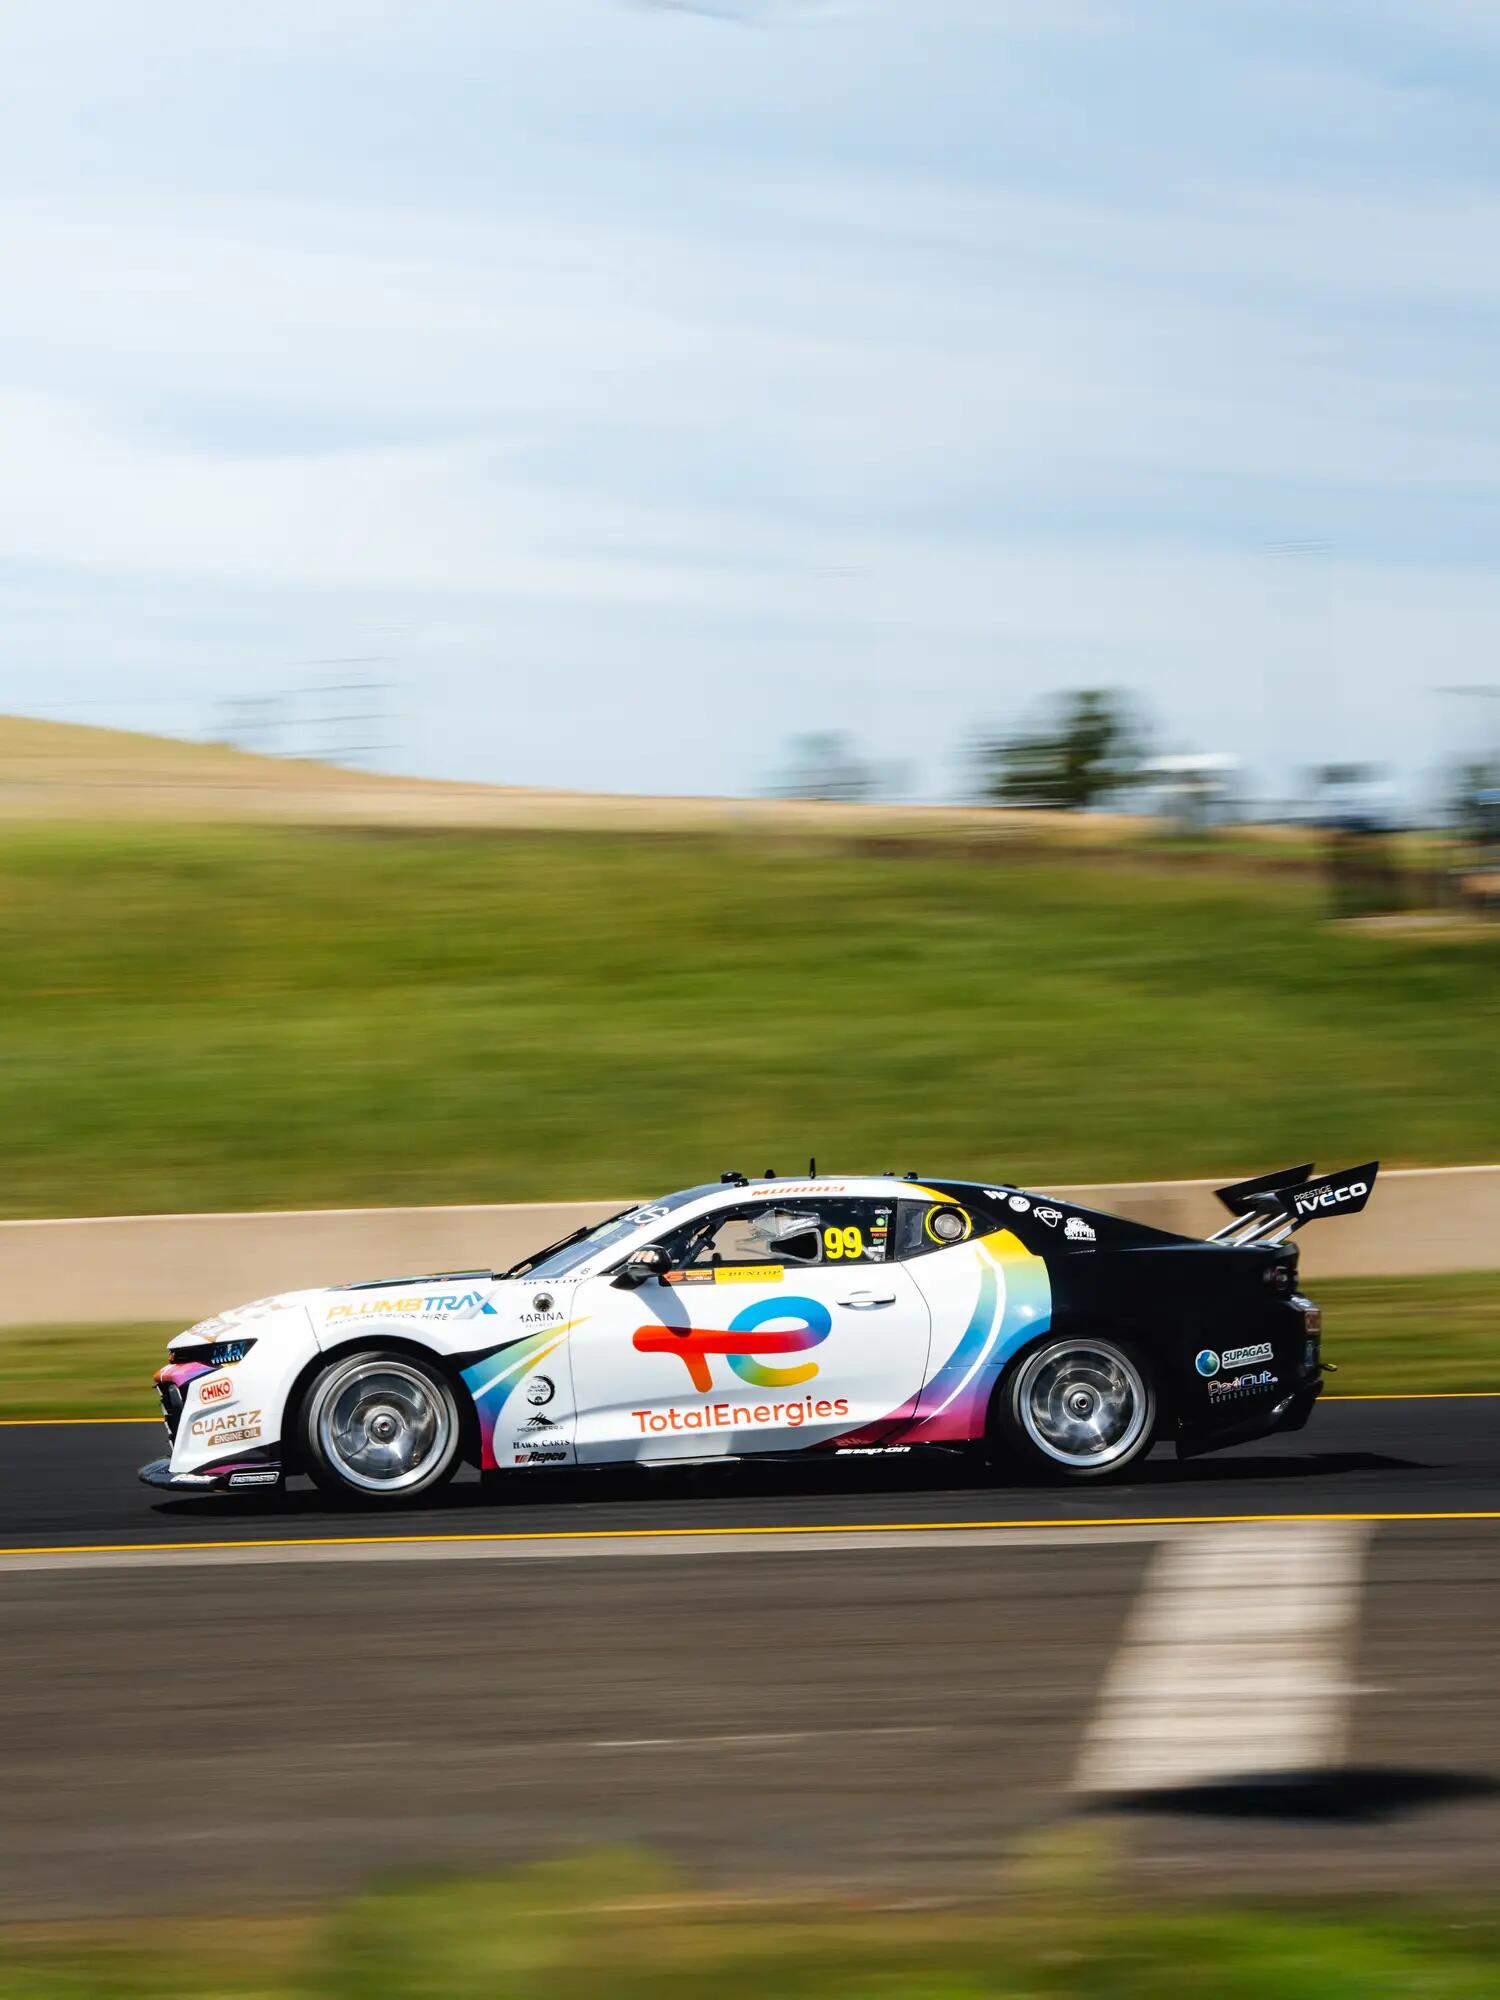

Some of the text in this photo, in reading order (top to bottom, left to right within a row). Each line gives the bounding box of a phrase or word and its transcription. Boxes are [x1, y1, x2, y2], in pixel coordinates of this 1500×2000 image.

[1293, 1184, 1333, 1202] PRESTIGE
[1296, 1182, 1368, 1215] IVECO
[824, 1226, 863, 1260] 99
[728, 1269, 781, 1277] DUNLOP
[326, 1290, 499, 1320] PLUMBTRAX
[420, 1313, 449, 1321] HIRE
[1223, 1344, 1270, 1362] SUPAGAS
[201, 1381, 231, 1401] CHIKO
[191, 1410, 262, 1436] QUARTZ
[632, 1395, 848, 1433] TotalEnergies
[213, 1427, 261, 1444] ENGINE OIL
[527, 1451, 567, 1464] Repco
